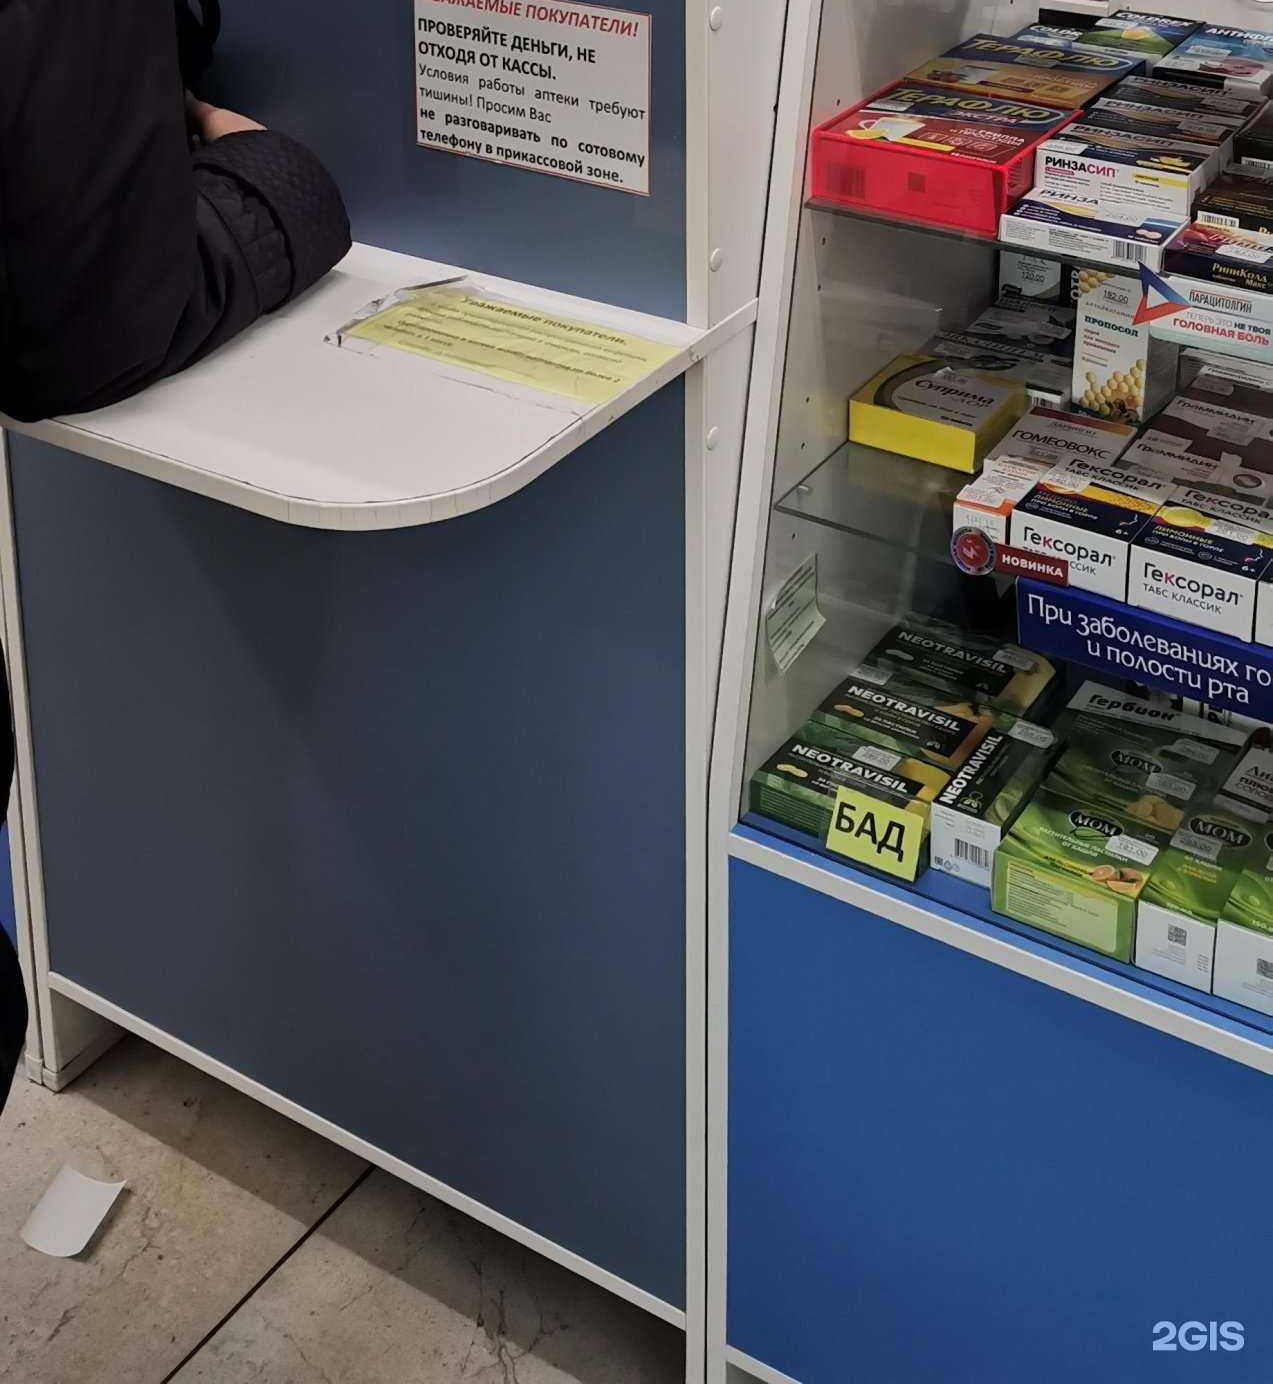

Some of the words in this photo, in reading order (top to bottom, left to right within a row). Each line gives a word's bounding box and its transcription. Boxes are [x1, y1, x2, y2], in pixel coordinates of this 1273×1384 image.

[526, 4, 639, 37] ПОКУПАТЕЛИ!
[418, 17, 508, 47] ПРОВЕРЯЙТЕ
[511, 35, 573, 61] ДЕНЬГИ,
[577, 47, 596, 64] НЕ
[963, 39, 1119, 67] ТЕРАФЛЮ
[419, 41, 476, 64] ОТХОДЯ
[480, 53, 499, 68] ОТ
[502, 57, 557, 80] КАССЫ.
[419, 63, 469, 85] Условия
[479, 77, 525, 97] работы
[535, 87, 580, 107] аптеки
[588, 99, 645, 121] требуют
[420, 86, 473, 107] тишины!
[477, 96, 526, 117] Просим
[529, 109, 552, 123] Вас
[886, 89, 1051, 119] ТЕРАФЛЮ
[420, 108, 435, 121] не
[445, 113, 541, 143] разговаривать
[551, 135, 568, 148] по
[578, 140, 645, 167] сотовому
[420, 129, 482, 154] телефону
[486, 143, 493, 154] в
[496, 146, 583, 174] прикассовой
[587, 165, 624, 183] зоне.
[1045, 156, 1116, 177] РИНЗАСИП
[1040, 189, 1099, 205] РИНЗА
[461, 295, 543, 325] Уважаемые
[1189, 291, 1252, 313] ПАРАЦИТОЛГИН
[1173, 318, 1234, 338] ГОЛОВНАЯ
[1237, 333, 1269, 346] БОЛЬ
[1234, 322, 1246, 330] НЕ
[1248, 325, 1271, 335] ТВОЯ
[1012, 429, 1115, 460] ГОМЕОВОКС
[1068, 458, 1162, 490] Гексорал
[1023, 526, 1112, 566] Гексорал
[1001, 553, 1064, 578] НОВИНКА
[1143, 563, 1239, 604] Гексорал
[1143, 583, 1169, 598] ТАБС
[1172, 592, 1222, 615] КЛАССИК
[898, 631, 1006, 674] NEOTRAVISIL
[1027, 593, 1071, 625] При
[1076, 614, 1238, 677] заболеваниях
[1088, 639, 1101, 656] и
[1107, 644, 1201, 689] полости
[1208, 677, 1249, 703] рта
[849, 685, 960, 732] NEOTRAVISIL
[1089, 694, 1174, 721] Гербион
[792, 744, 908, 794] NEOTRAVISIL
[939, 734, 1003, 805] NEOTRAVISIL
[835, 801, 905, 863] БАД
